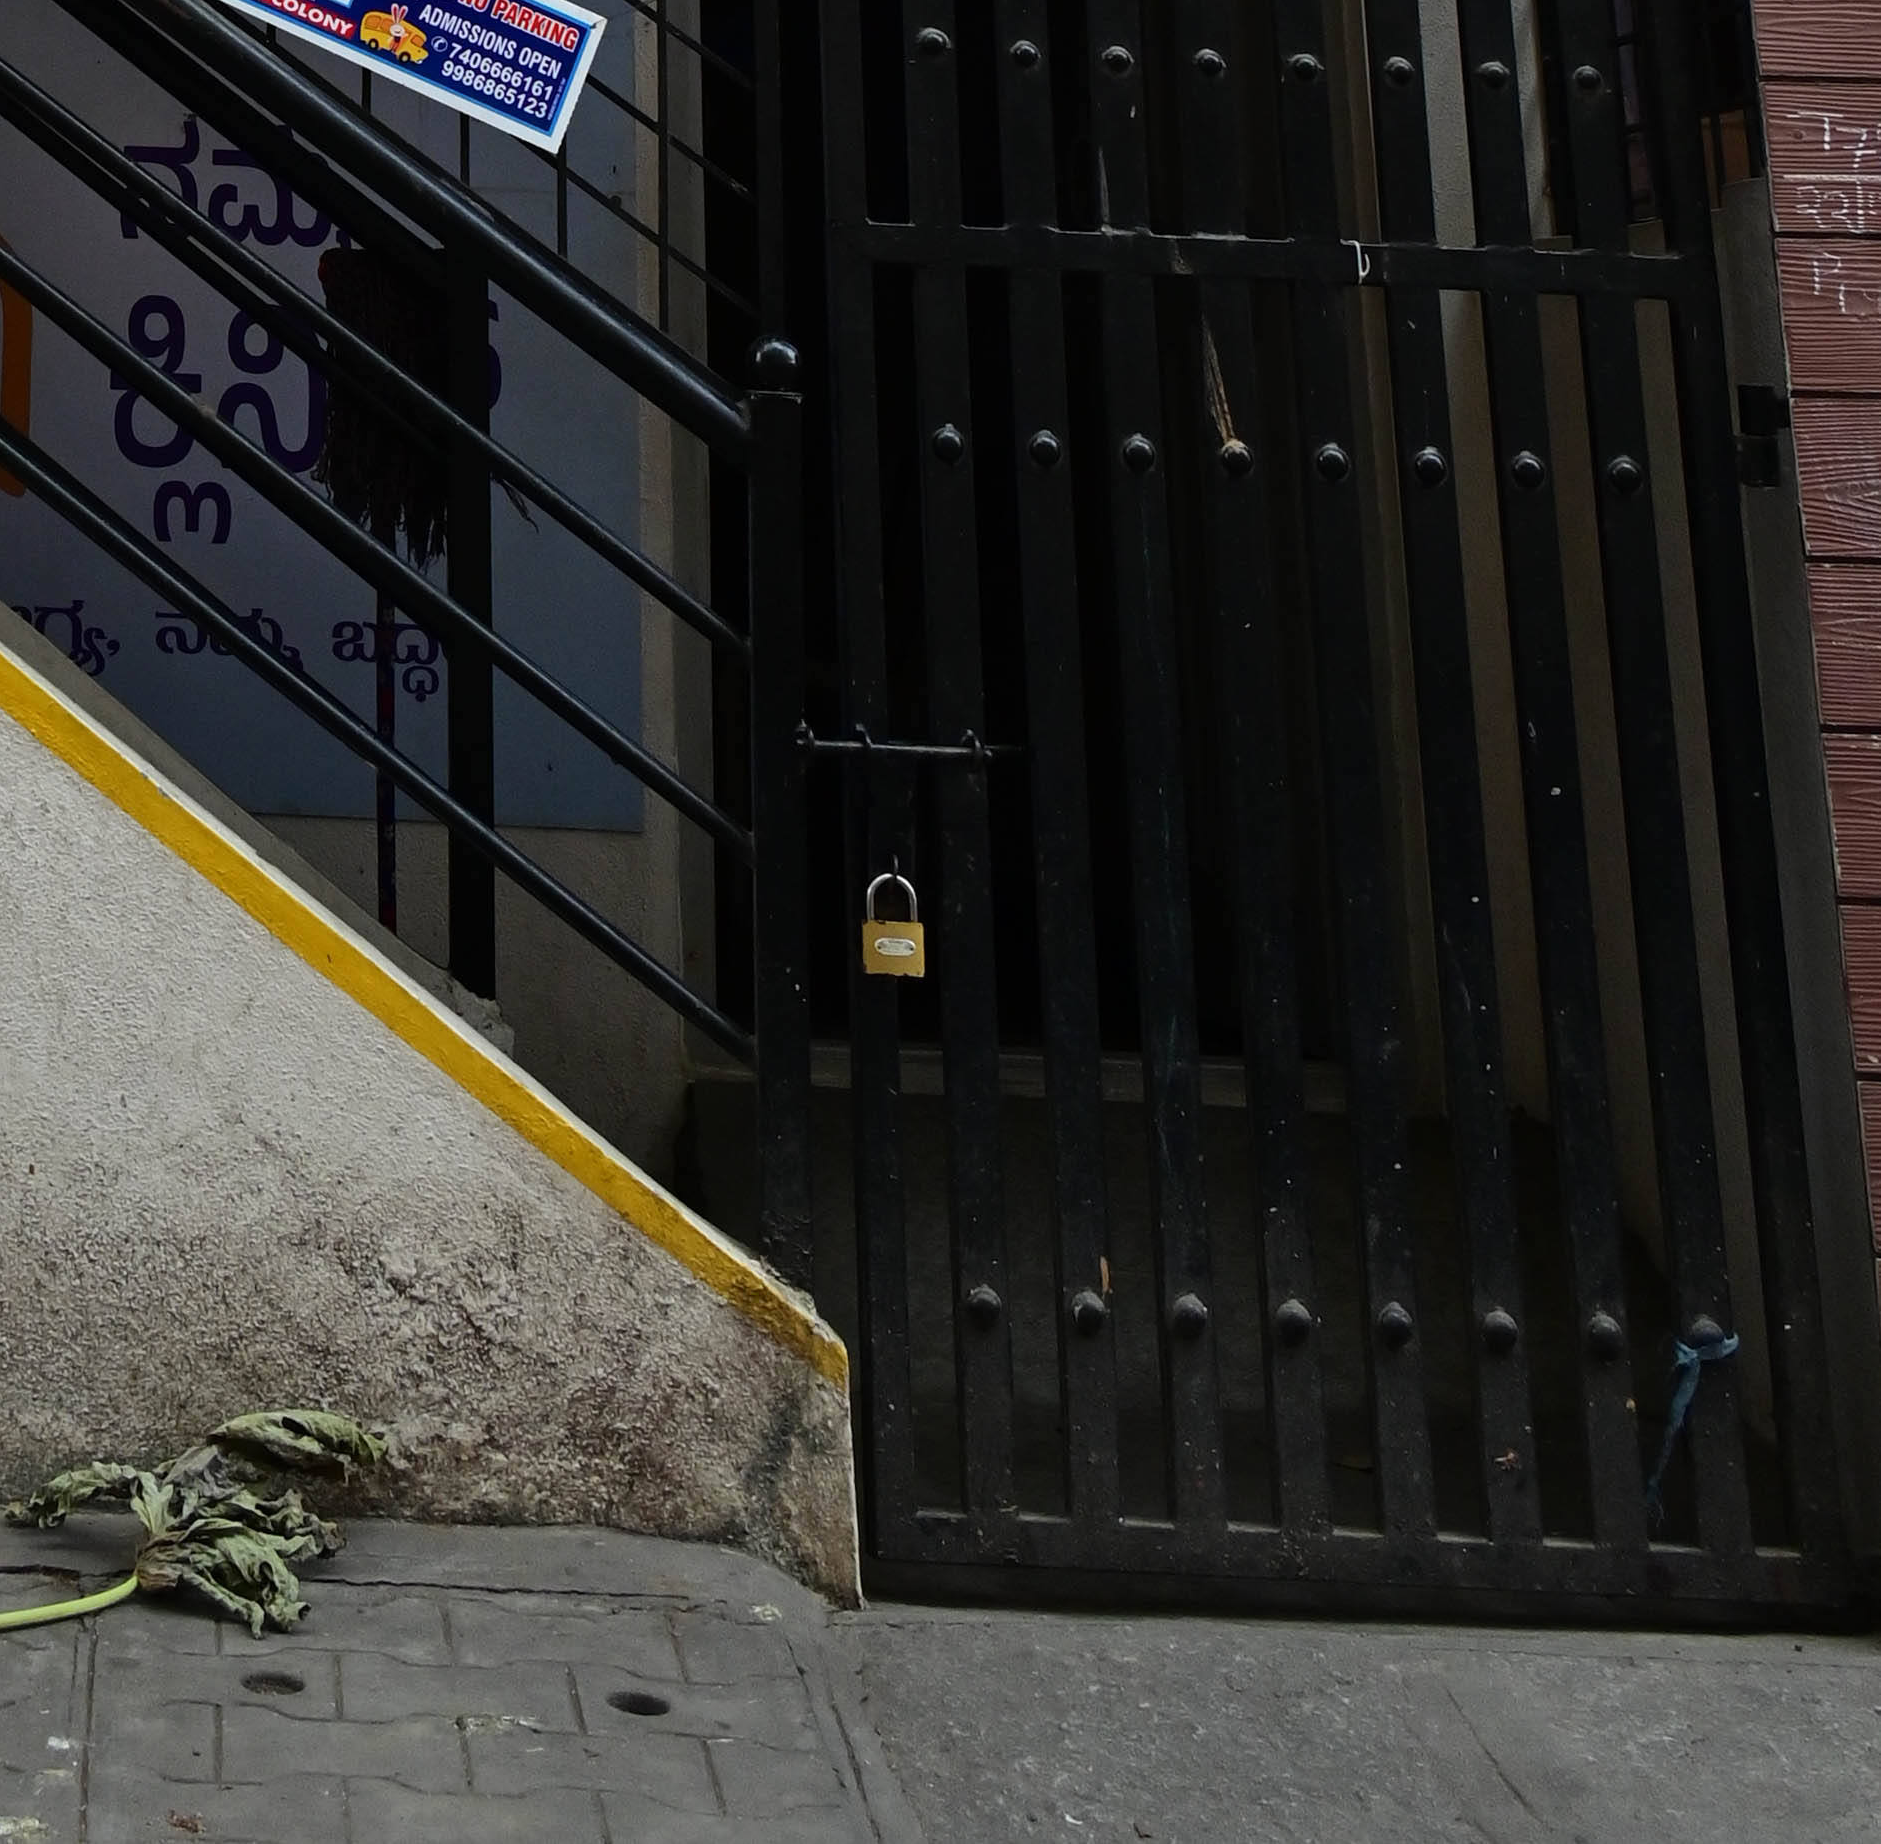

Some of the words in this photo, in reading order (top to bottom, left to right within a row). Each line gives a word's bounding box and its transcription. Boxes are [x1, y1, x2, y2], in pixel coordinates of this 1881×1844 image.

[418, 3, 518, 60] ADMISSIONS
[518, 46, 563, 81] OPEN
[448, 42, 554, 101] 7406666161
[441, 60, 548, 119] 9986865123
